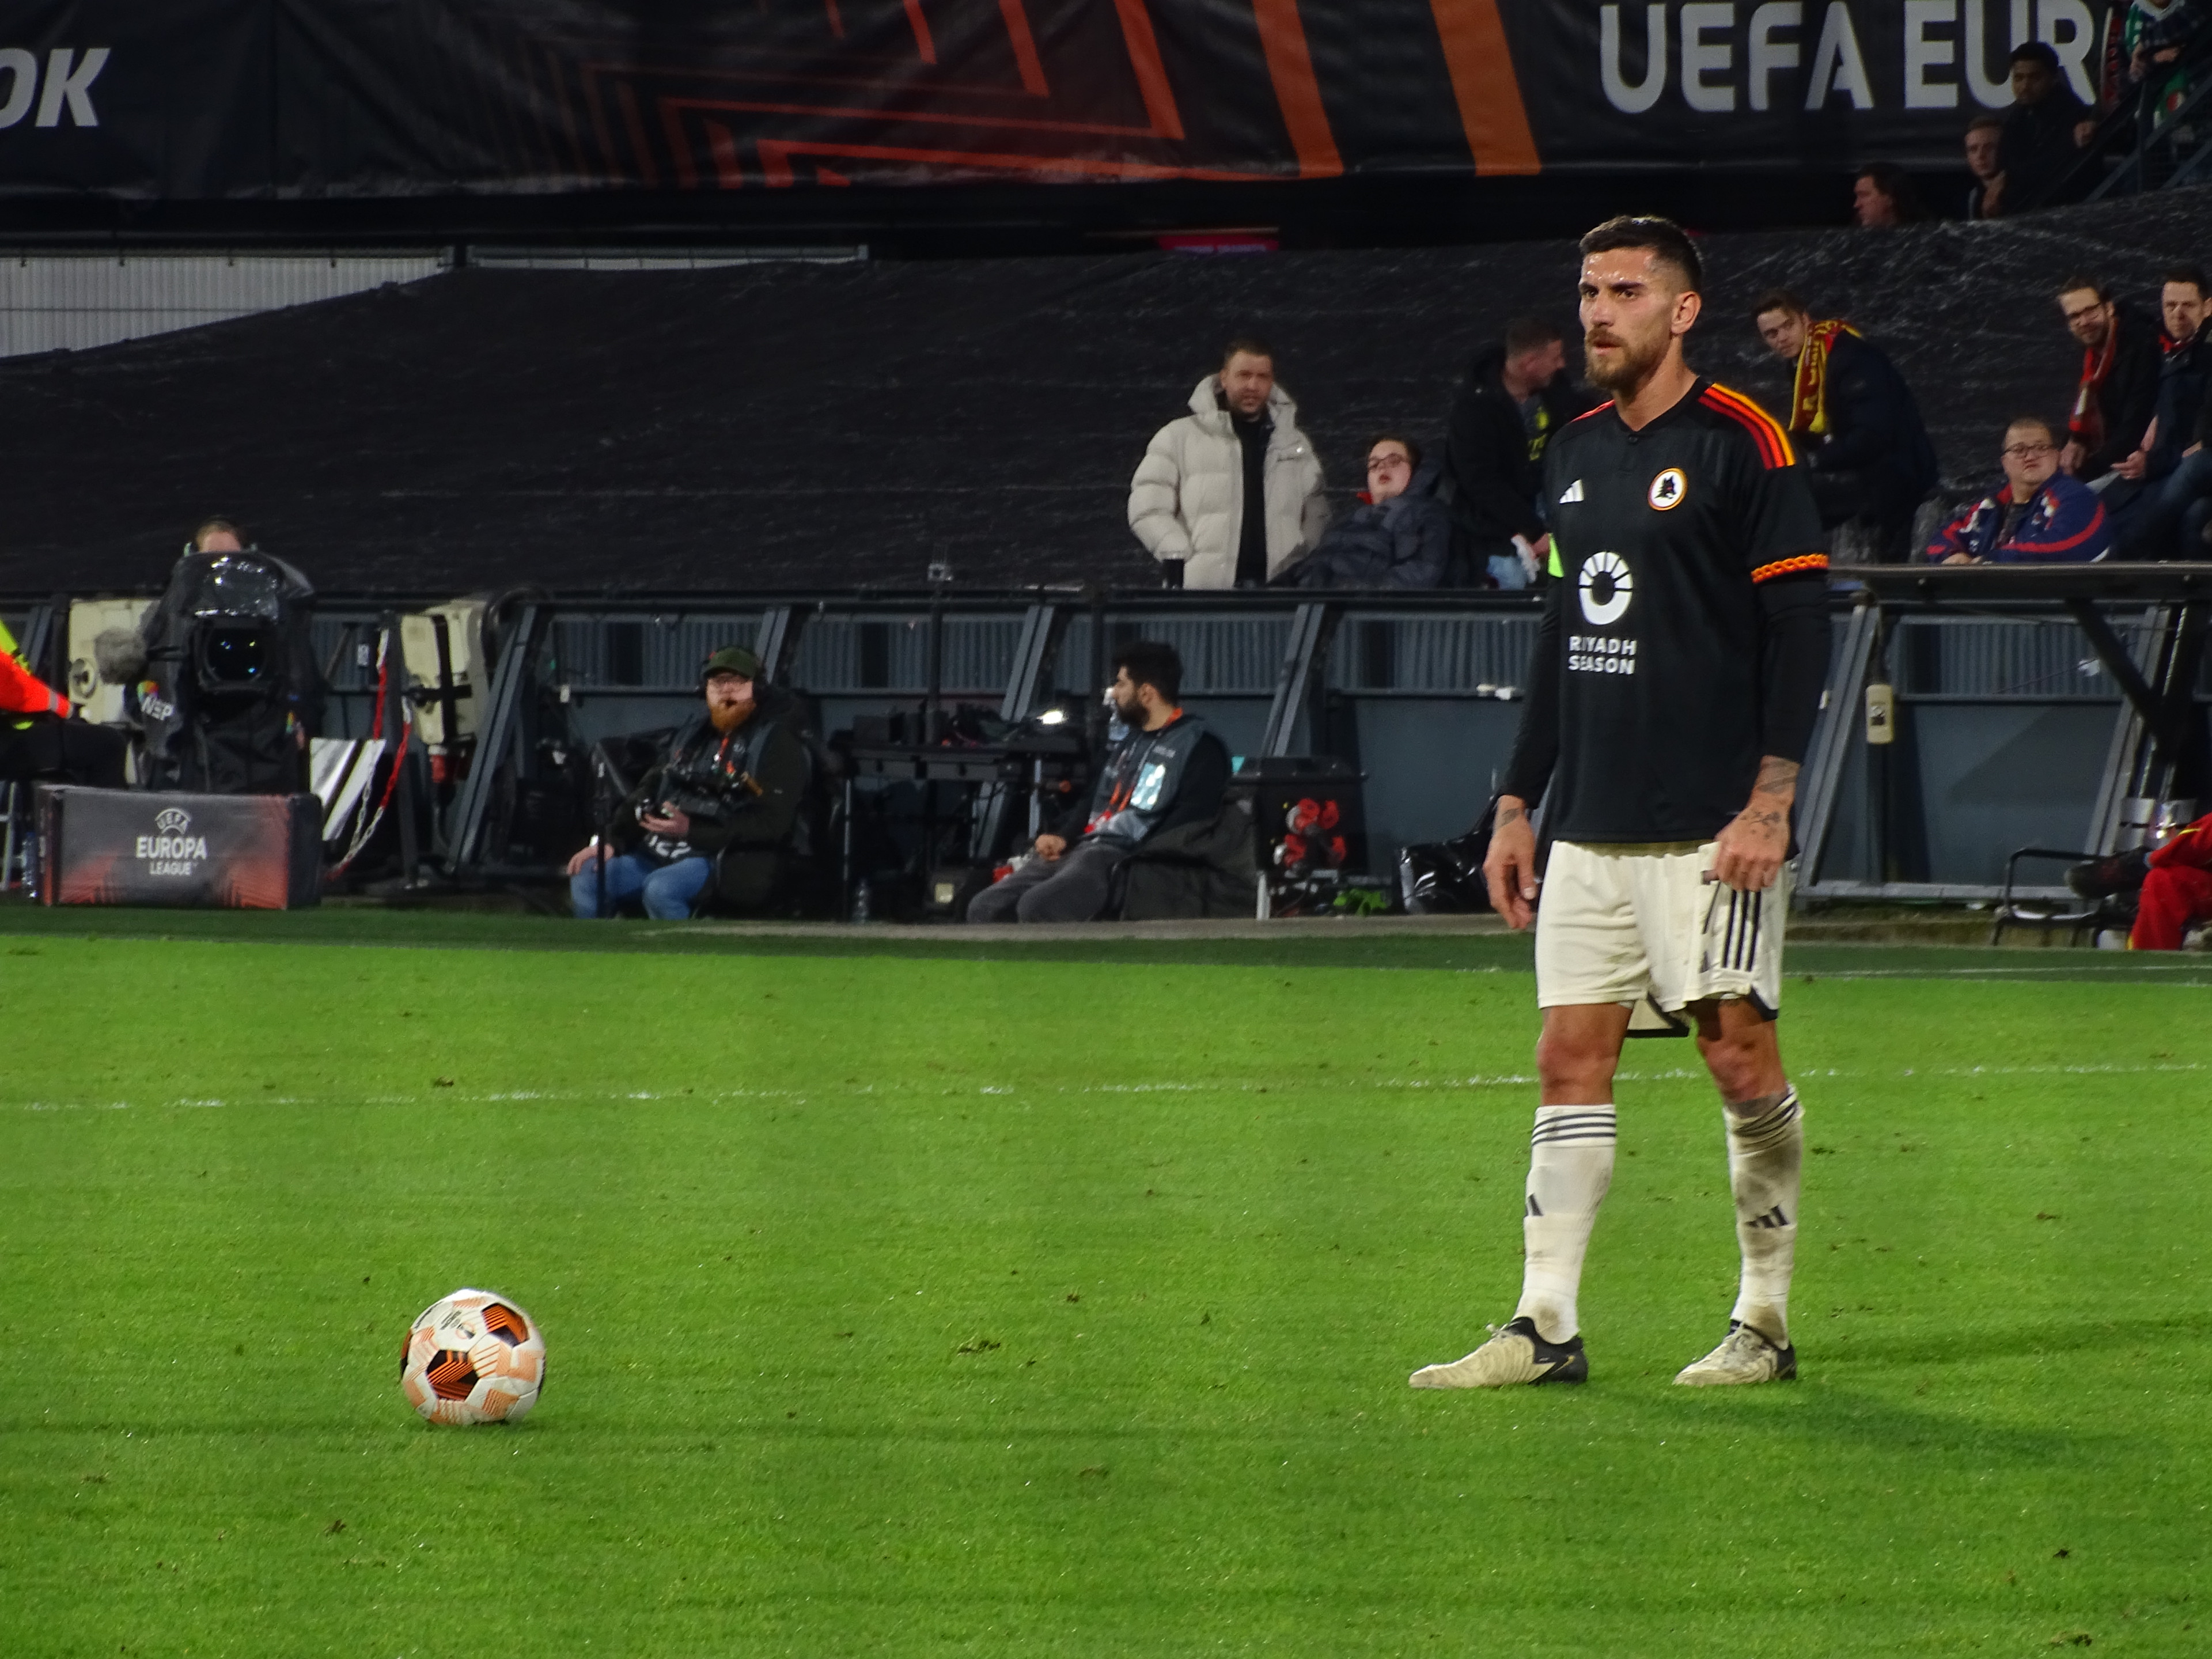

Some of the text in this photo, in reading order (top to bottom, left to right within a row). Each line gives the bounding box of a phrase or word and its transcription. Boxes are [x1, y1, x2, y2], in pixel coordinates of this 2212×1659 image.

[1600, 1, 1874, 113] UEFA
[1569, 635, 1637, 656] RIYADH
[1568, 655, 1636, 675] SEASON
[141, 695, 175, 721] NEP
[155, 808, 191, 835] UEFA
[136, 836, 207, 859] EUROPA
[150, 861, 192, 875] LEAGUE
